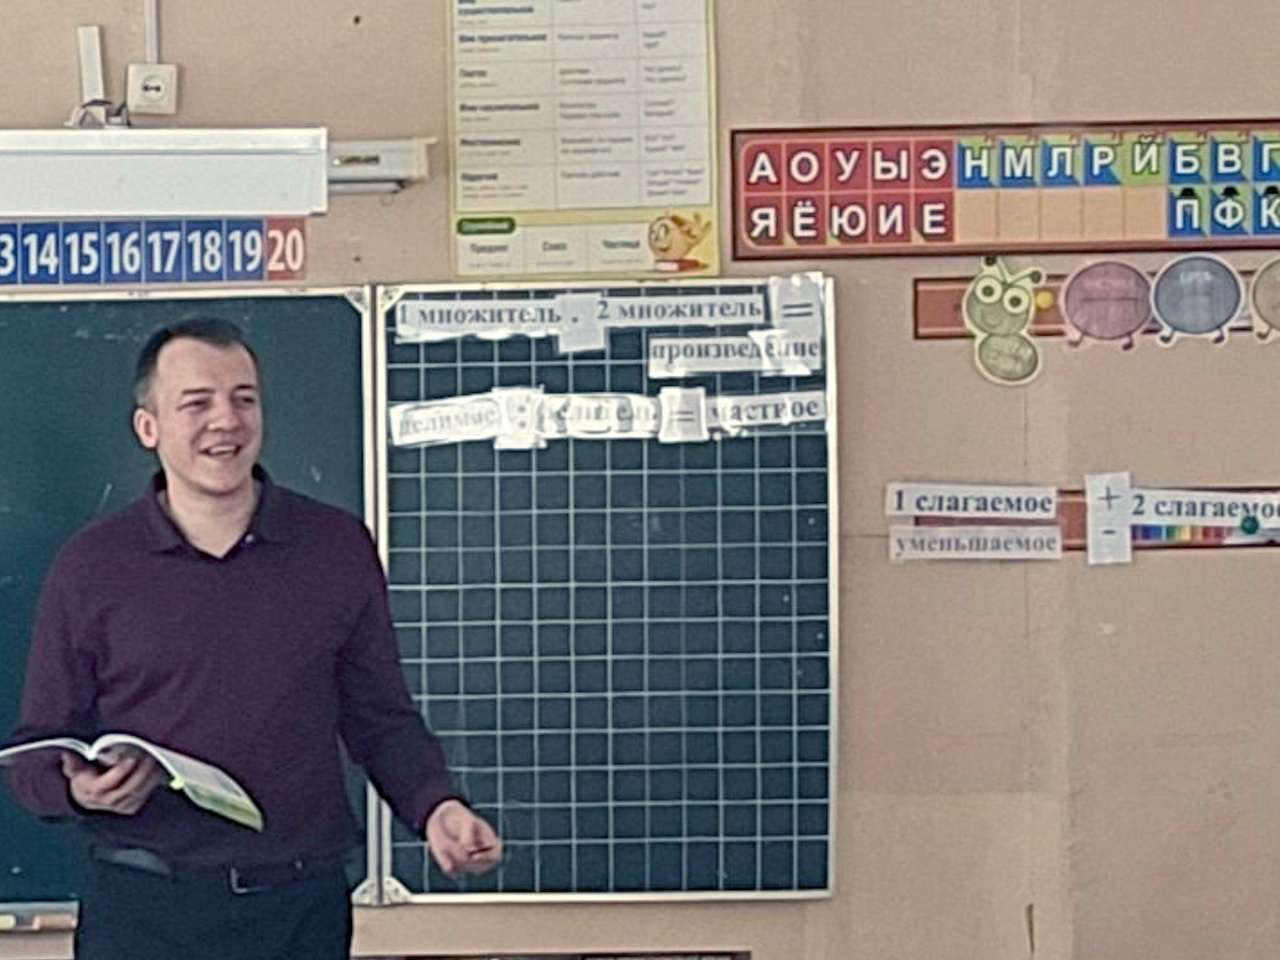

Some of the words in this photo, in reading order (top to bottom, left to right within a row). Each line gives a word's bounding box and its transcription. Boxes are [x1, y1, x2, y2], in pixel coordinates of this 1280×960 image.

[748, 152, 778, 183] А
[790, 151, 819, 182] О
[835, 150, 860, 181] У
[874, 150, 908, 180] Ы
[921, 149, 948, 179] Э
[965, 149, 988, 178] Н
[1004, 148, 1033, 177] М
[1048, 147, 1071, 177] Л
[1092, 147, 1114, 176] Р
[1133, 135, 1158, 174] Й
[1176, 145, 1200, 174] Б
[1217, 144, 1241, 173] В
[751, 207, 776, 238] Я
[793, 201, 817, 237] Ё
[831, 205, 866, 236] Ю
[878, 204, 903, 235] И
[923, 203, 946, 234] Е
[1176, 200, 1200, 230] П
[1215, 199, 1243, 228] Ф
[23, 233, 59, 275] 14
[65, 232, 99, 274] 15
[106, 231, 140, 274] 16
[147, 231, 181, 273] 17
[187, 230, 222, 273] 18
[228, 229, 262, 272] 19
[267, 228, 304, 271] 20
[419, 306, 562, 325] множитель
[597, 300, 609, 319] 2
[619, 300, 762, 320] множитель
[894, 490, 904, 511] 1
[915, 491, 1053, 513] слагаемое
[1131, 494, 1145, 516] 2
[895, 535, 1057, 558] уменьшаемое
